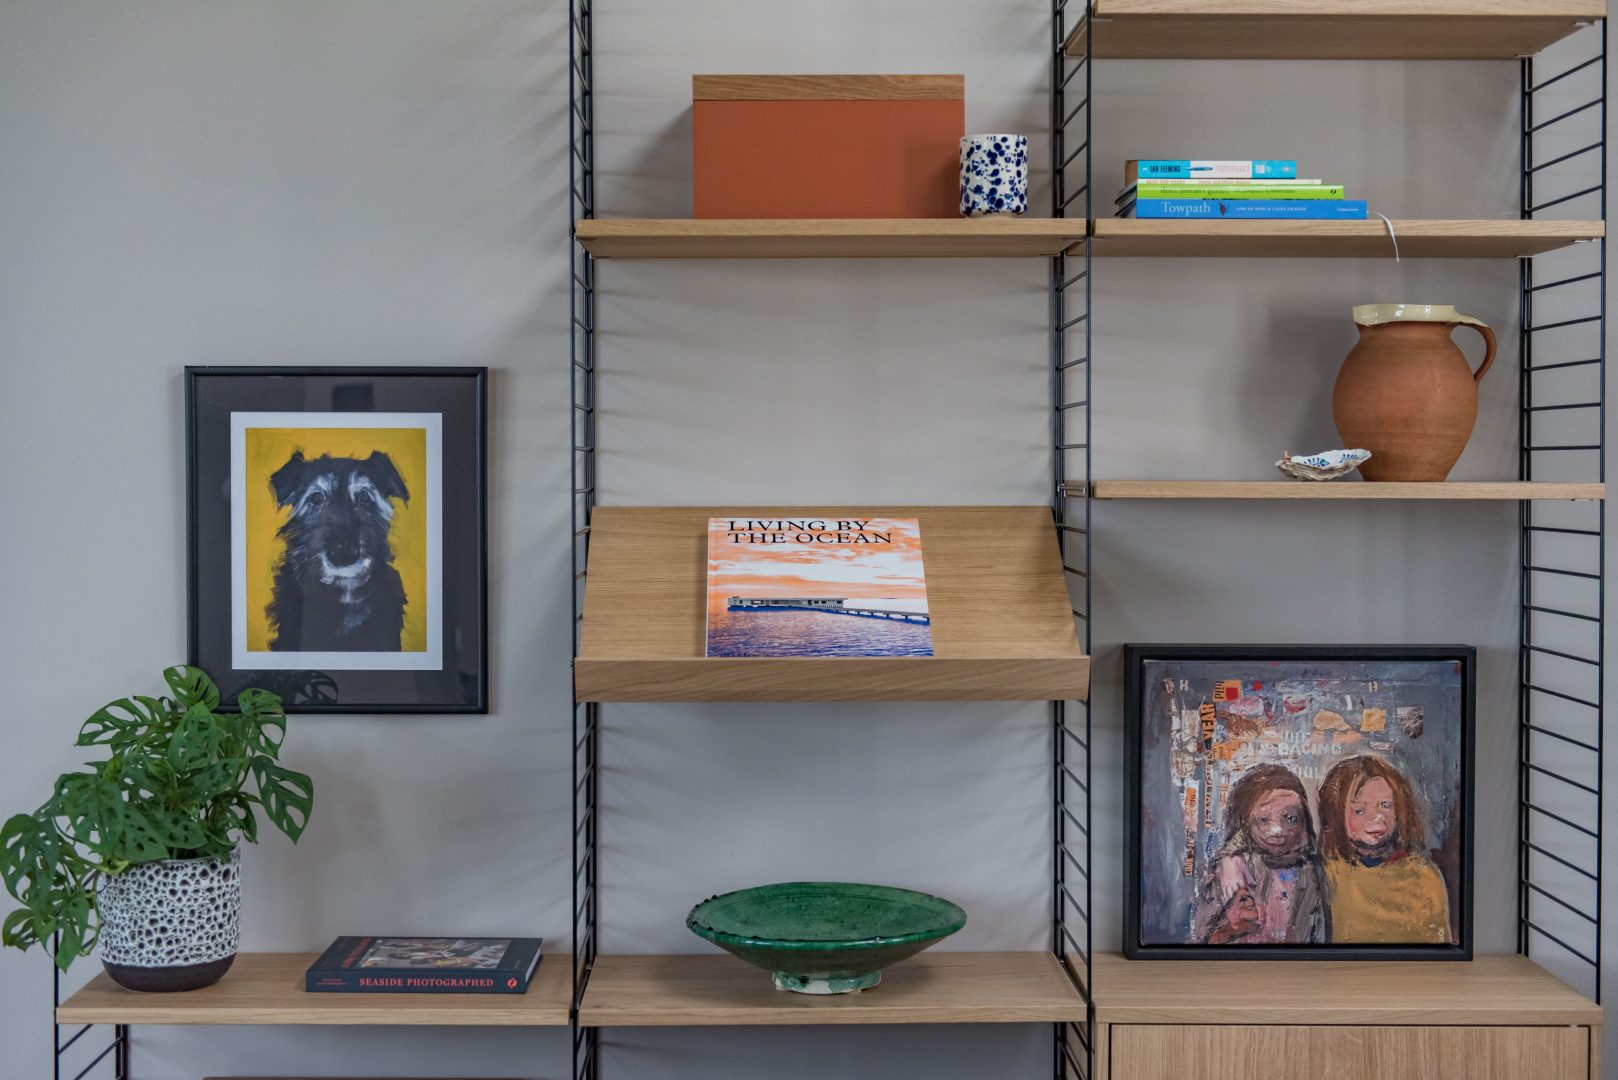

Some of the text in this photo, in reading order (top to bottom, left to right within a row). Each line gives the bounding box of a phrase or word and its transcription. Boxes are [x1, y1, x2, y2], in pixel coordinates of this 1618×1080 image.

[1160, 165, 1181, 173] FLEMING
[1160, 201, 1211, 216] Towpath
[727, 520, 869, 532] LIVING BY
[727, 532, 893, 544] THE OCEAN
[359, 978, 494, 987] SEASIDE PHOTOGRAPHED
